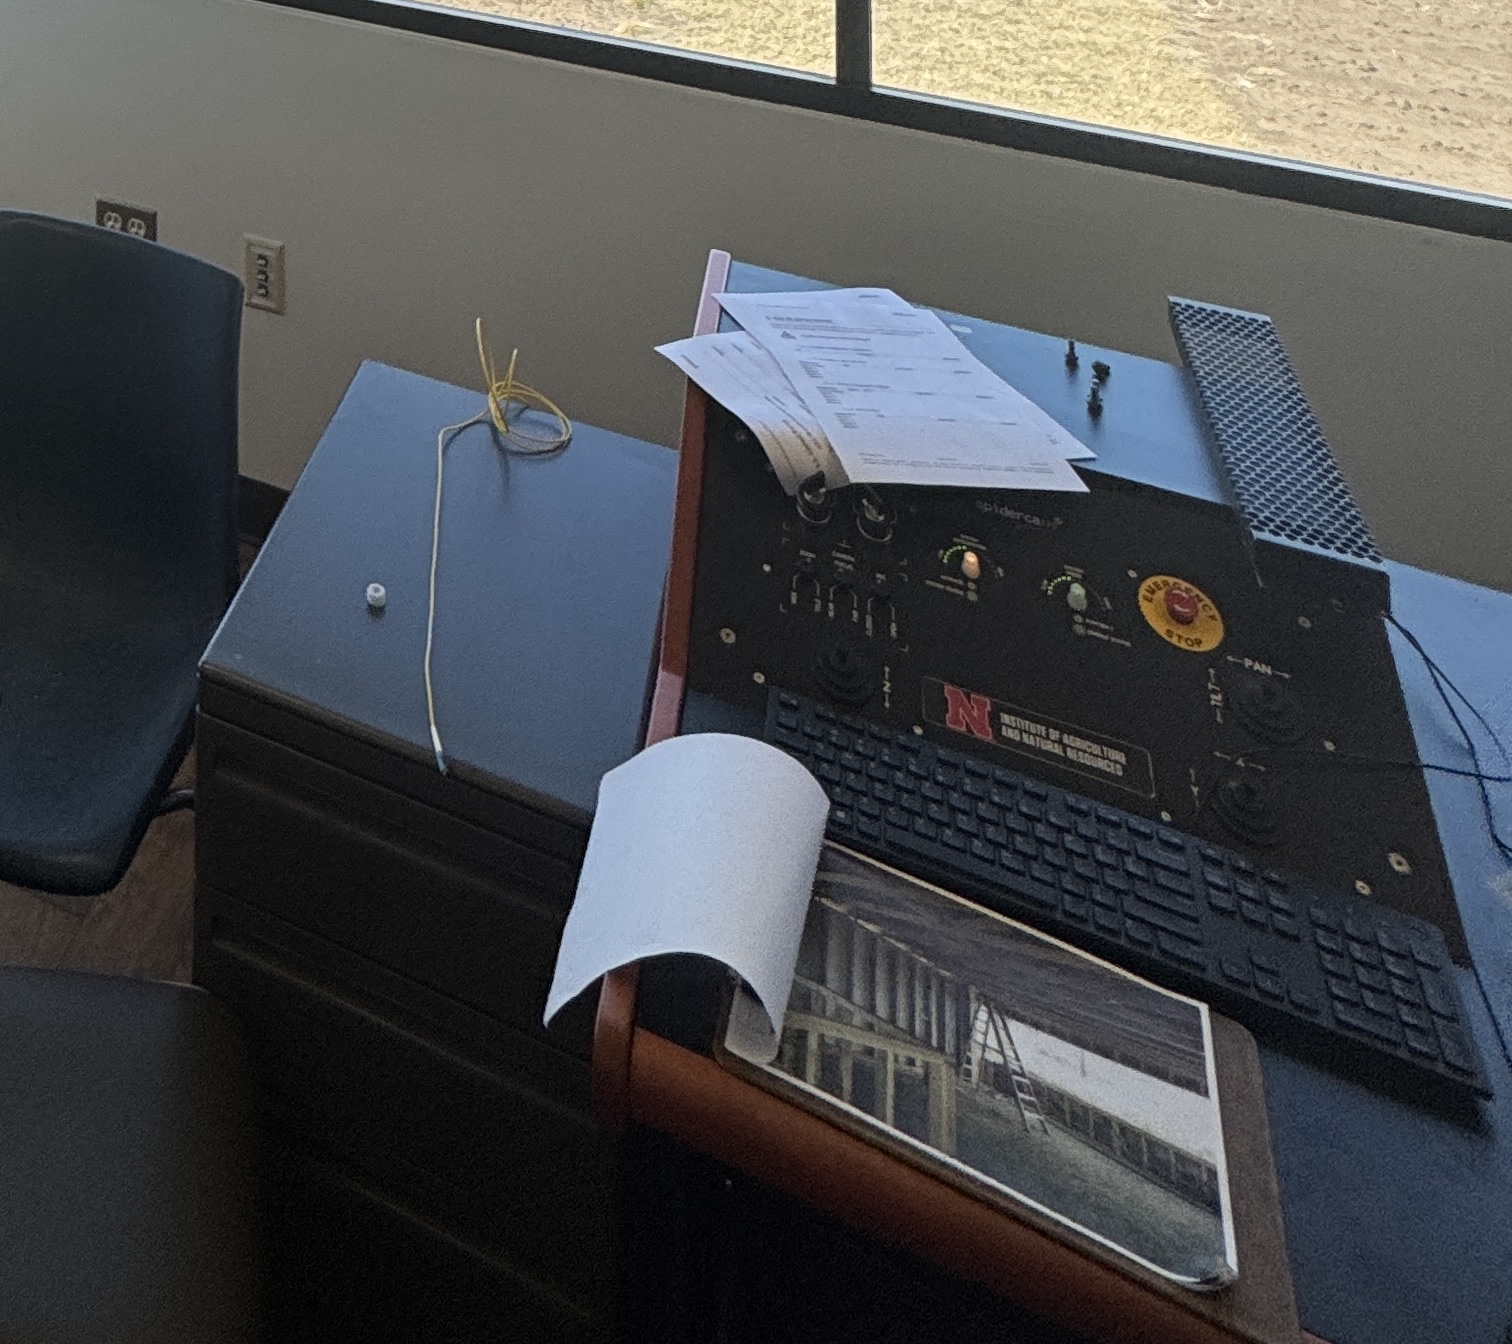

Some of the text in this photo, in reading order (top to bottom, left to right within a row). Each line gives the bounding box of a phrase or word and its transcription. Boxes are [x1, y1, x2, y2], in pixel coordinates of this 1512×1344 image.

[1141, 579, 1219, 623] EMERGENCY
[1164, 628, 1204, 648] STOP
[1243, 657, 1274, 677] PAN
[944, 683, 995, 743] N
[999, 712, 1128, 766] INSTITUTE OF AGRICULTURE
[1000, 724, 1125, 777] AND NATURAL RESOURCES
